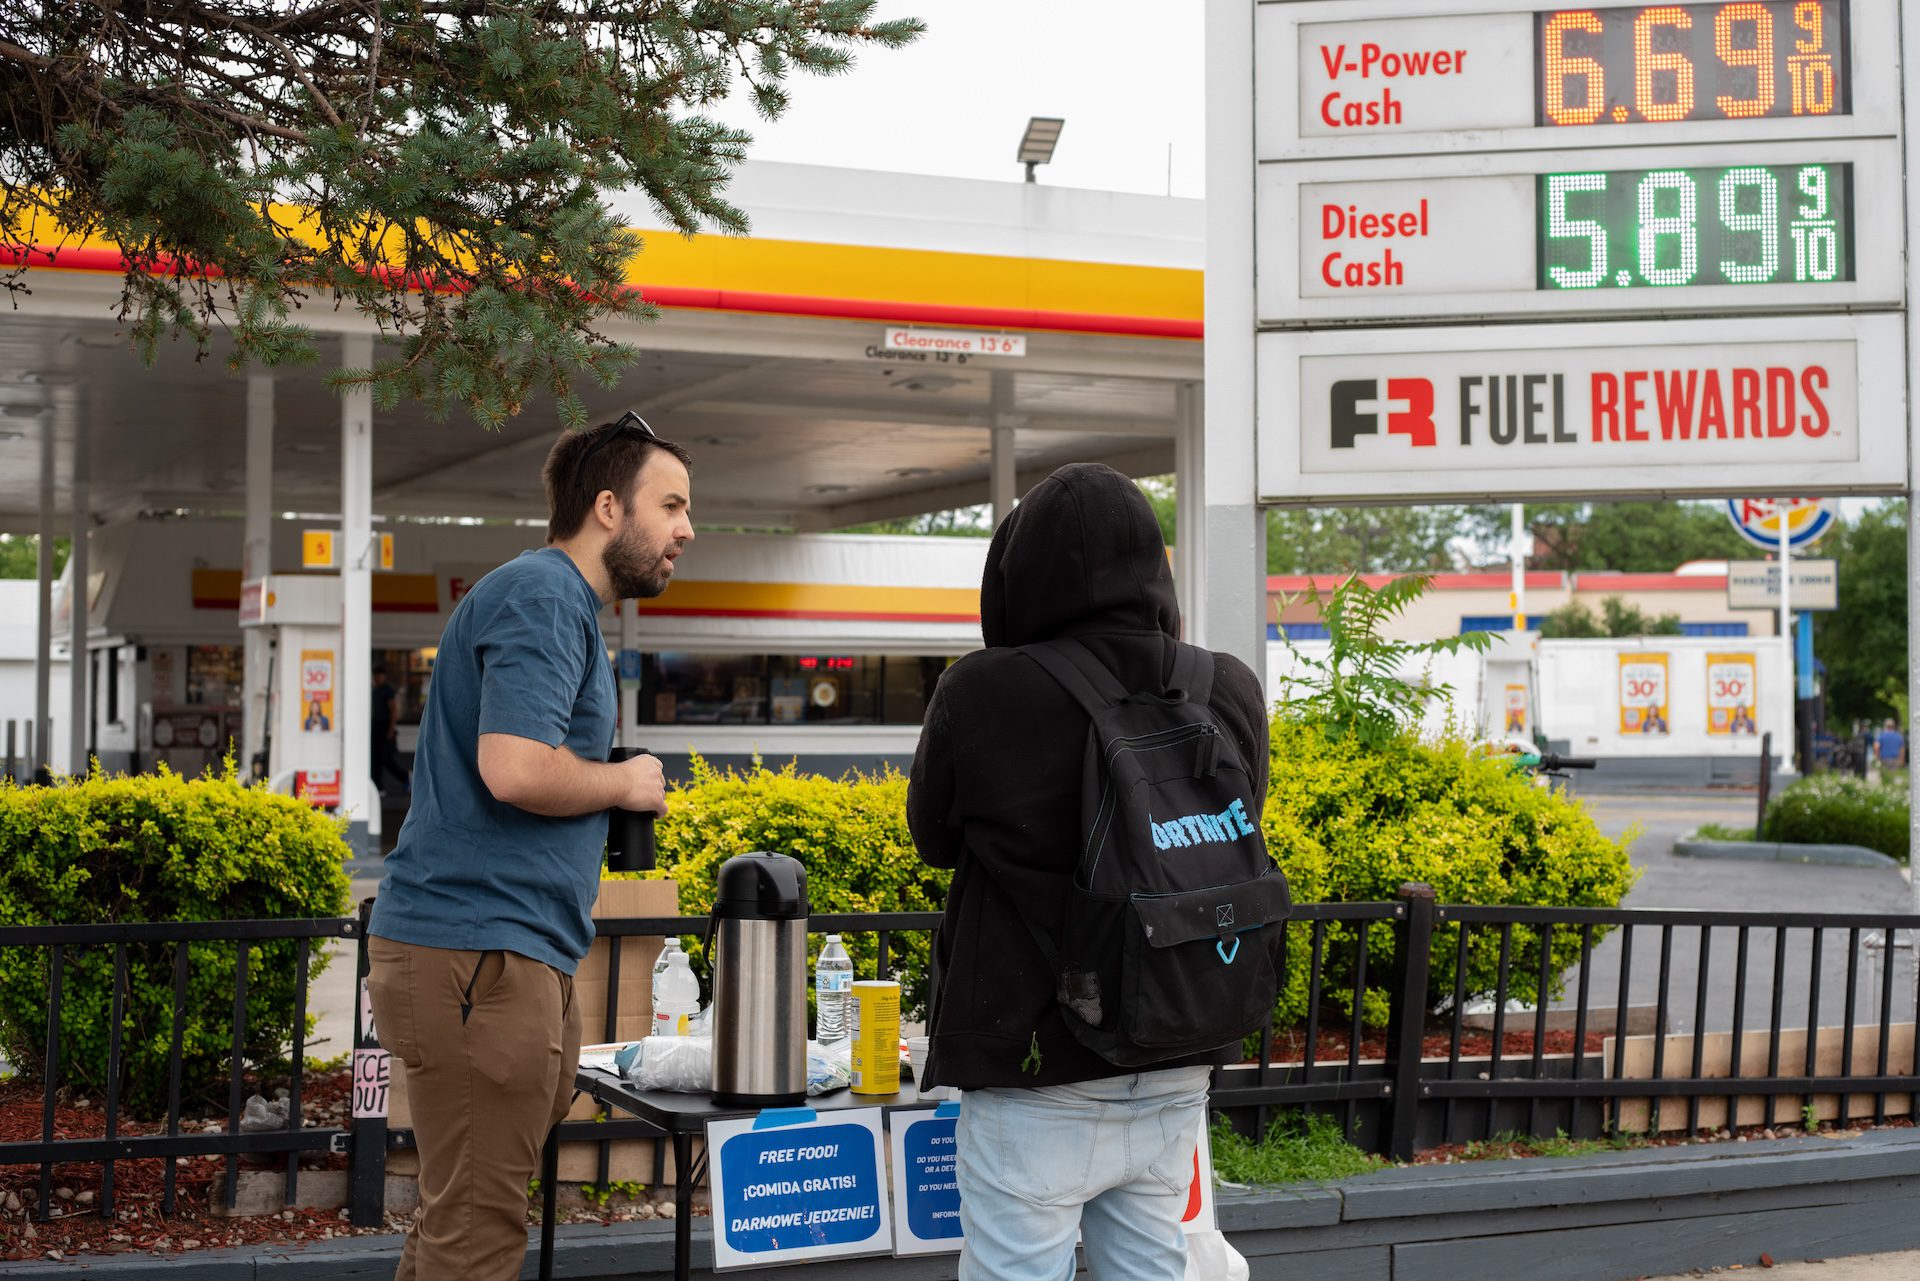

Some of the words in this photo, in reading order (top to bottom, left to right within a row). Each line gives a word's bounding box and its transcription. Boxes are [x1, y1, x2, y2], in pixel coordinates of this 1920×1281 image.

[1320, 43, 1467, 80] V-Power
[1545, 3, 1774, 125] 6.69
[1320, 88, 1403, 127] Cash
[1322, 198, 1428, 240] Diesel
[1549, 168, 1778, 288] 5.89
[1321, 248, 1403, 288] Cash
[893, 332, 971, 350] Clearance
[1459, 373, 1578, 445] FUEL
[1591, 365, 1830, 442] REWARDS
[1149, 797, 1255, 850] ORTNITE
[356, 1053, 391, 1083] ICE
[759, 1148, 796, 1165] FREE
[797, 1144, 839, 1161] FOOD!
[931, 1137, 941, 1145] DO
[941, 1136, 955, 1144] YOU
[916, 1156, 927, 1164] DO
[927, 1155, 941, 1163] YOU
[941, 1154, 957, 1162] NEE
[924, 1165, 935, 1173] OR
[743, 1180, 801, 1201] ¡COMIDA
[803, 1175, 857, 1193] GRATIS!
[918, 1184, 929, 1192] DO
[929, 1183, 943, 1191] YOU
[943, 1182, 958, 1190] NEE
[731, 1213, 803, 1232] DARMOWE
[804, 1205, 875, 1225] JEDZENIE!
